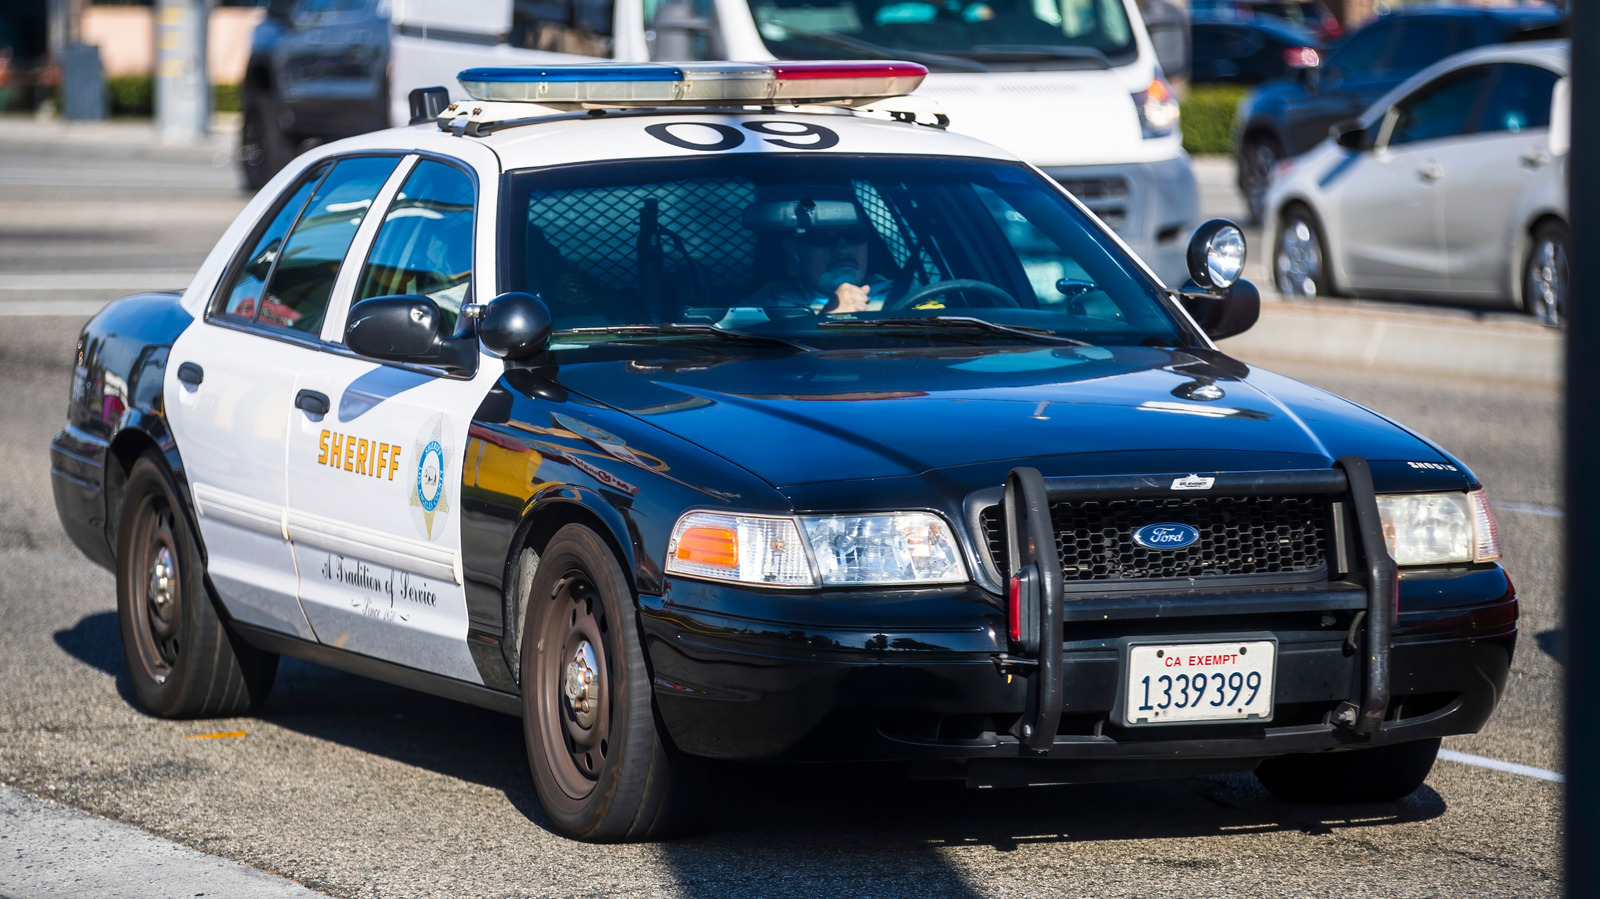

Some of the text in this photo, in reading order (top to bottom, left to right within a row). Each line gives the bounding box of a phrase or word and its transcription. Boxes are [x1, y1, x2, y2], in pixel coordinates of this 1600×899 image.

[644, 121, 839, 151] 09
[318, 429, 401, 481] SHERIFF
[1150, 527, 1185, 543] Ford
[322, 553, 437, 609] A Tradition of Service
[1165, 654, 1238, 668] CA EXEMPT
[1138, 670, 1262, 711] 1339399
